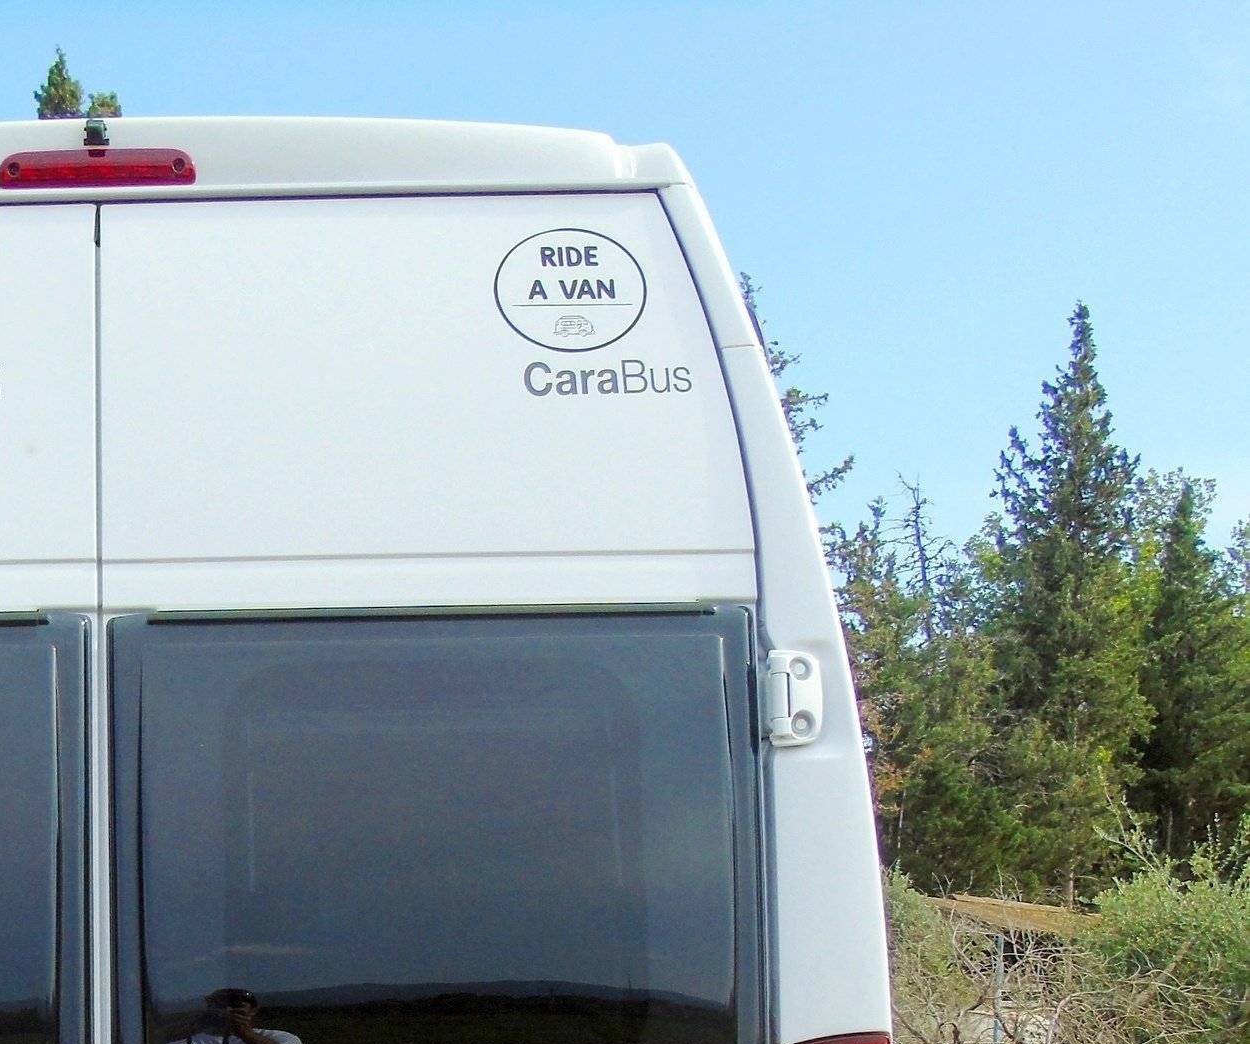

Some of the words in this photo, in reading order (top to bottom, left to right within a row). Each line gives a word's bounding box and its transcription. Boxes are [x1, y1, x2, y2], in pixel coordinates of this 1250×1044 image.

[540, 246, 599, 266] RIDE
[528, 279, 548, 299] A
[558, 279, 616, 299] VAN
[523, 359, 692, 396] CaraBus
